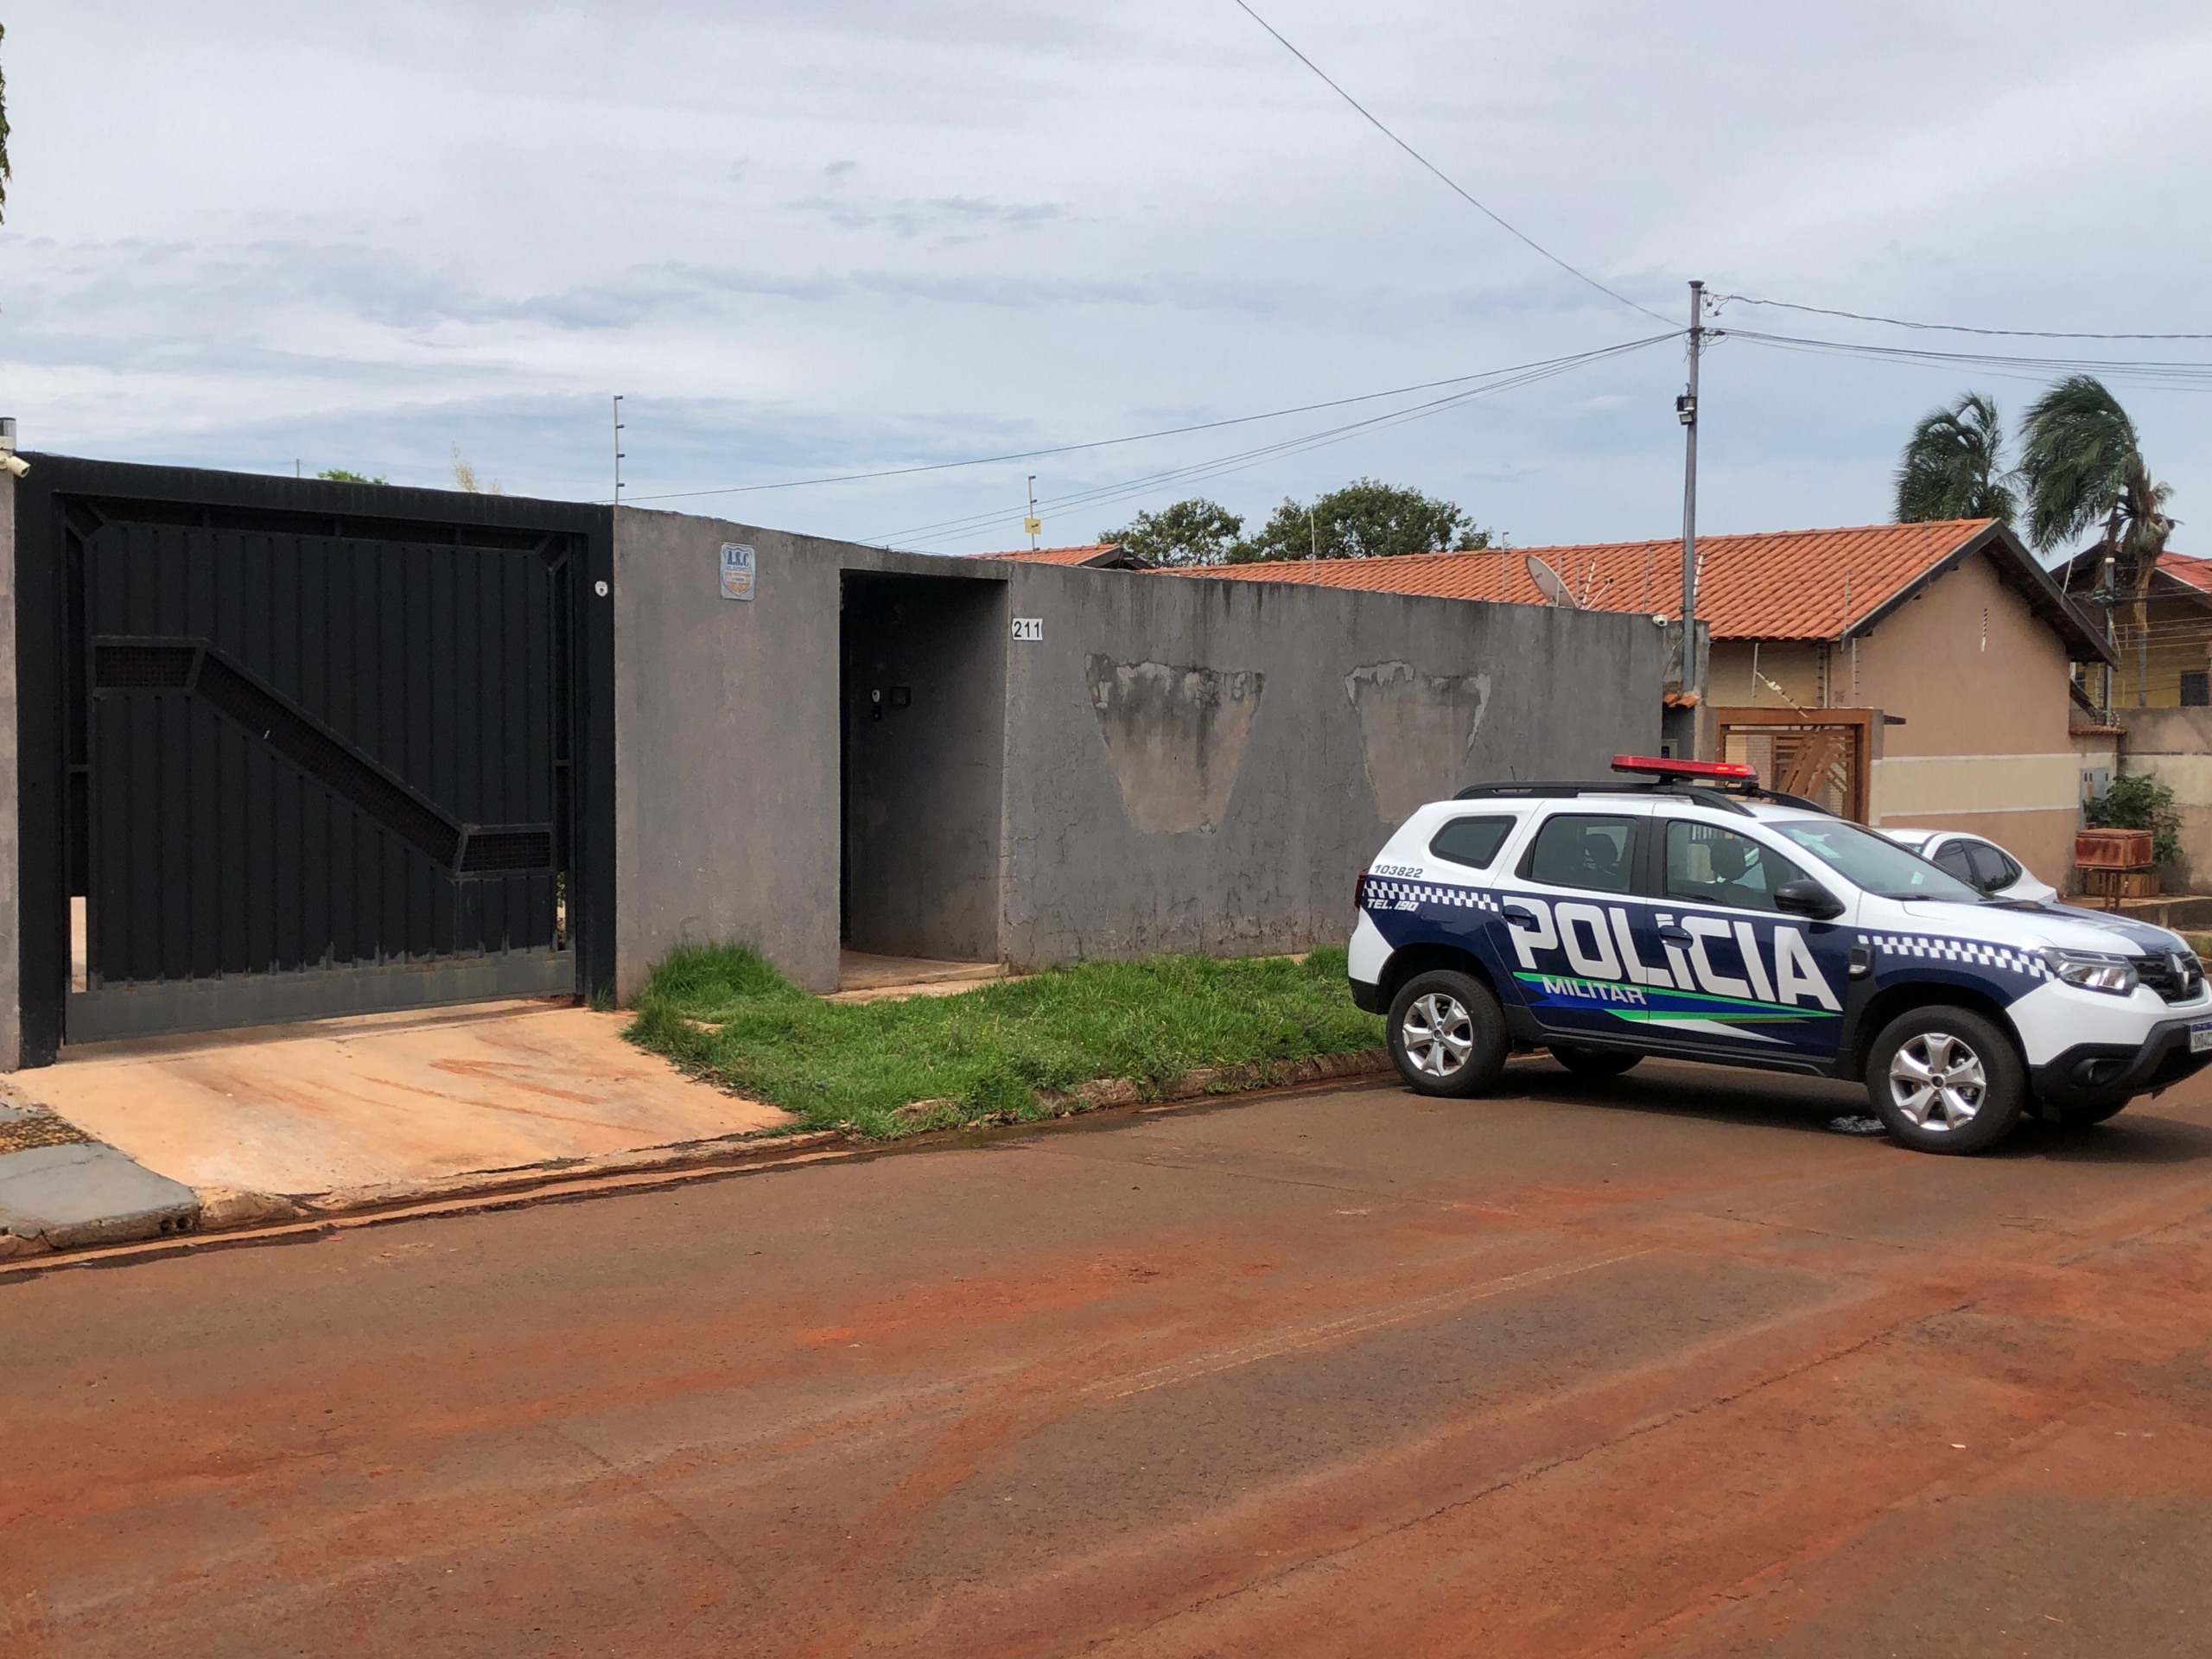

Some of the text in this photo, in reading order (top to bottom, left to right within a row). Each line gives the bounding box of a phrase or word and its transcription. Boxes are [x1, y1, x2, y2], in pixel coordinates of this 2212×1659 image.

[1014, 620, 1039, 638] 211
[1375, 864, 1423, 879] 103822
[1367, 899, 1420, 912] TEL. 190
[1541, 976, 1647, 1005] MILITAR
